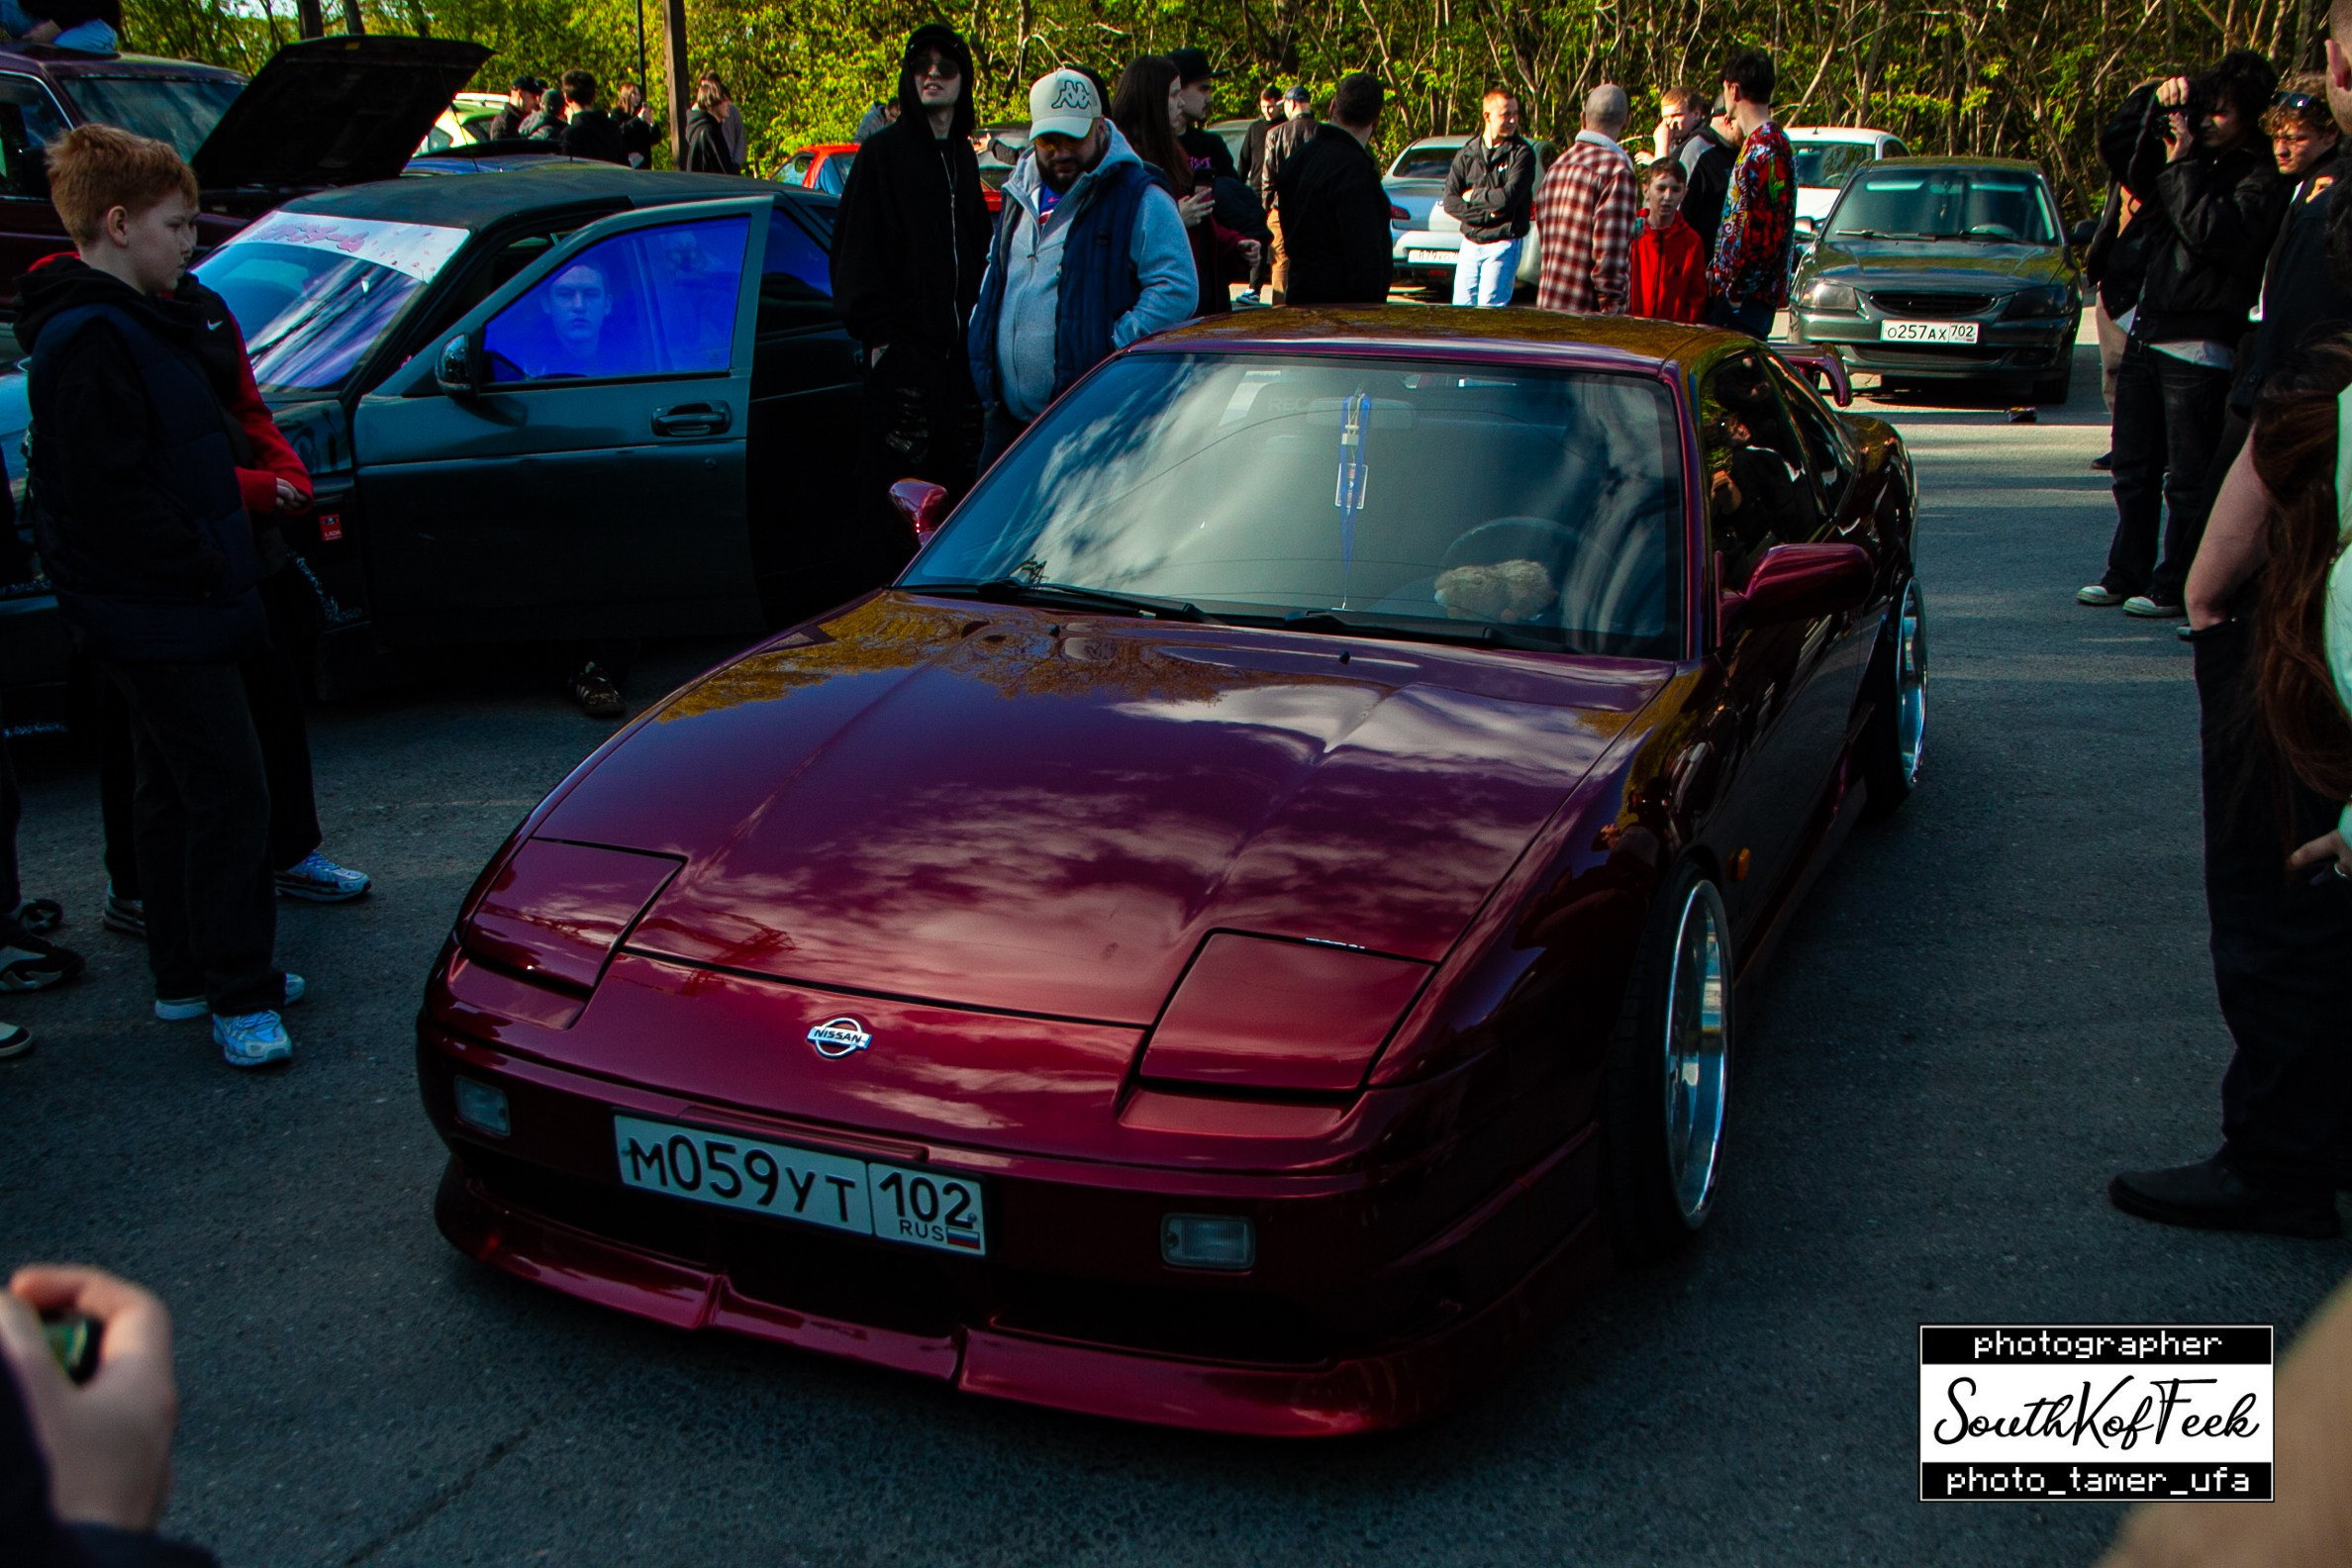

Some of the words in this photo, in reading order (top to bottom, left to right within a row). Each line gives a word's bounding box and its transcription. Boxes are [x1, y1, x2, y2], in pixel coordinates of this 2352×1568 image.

[1950, 324, 1975, 338] 702
[814, 1029, 863, 1043] NISSAN
[879, 1171, 973, 1228] 102
[899, 1219, 944, 1242] RUS
